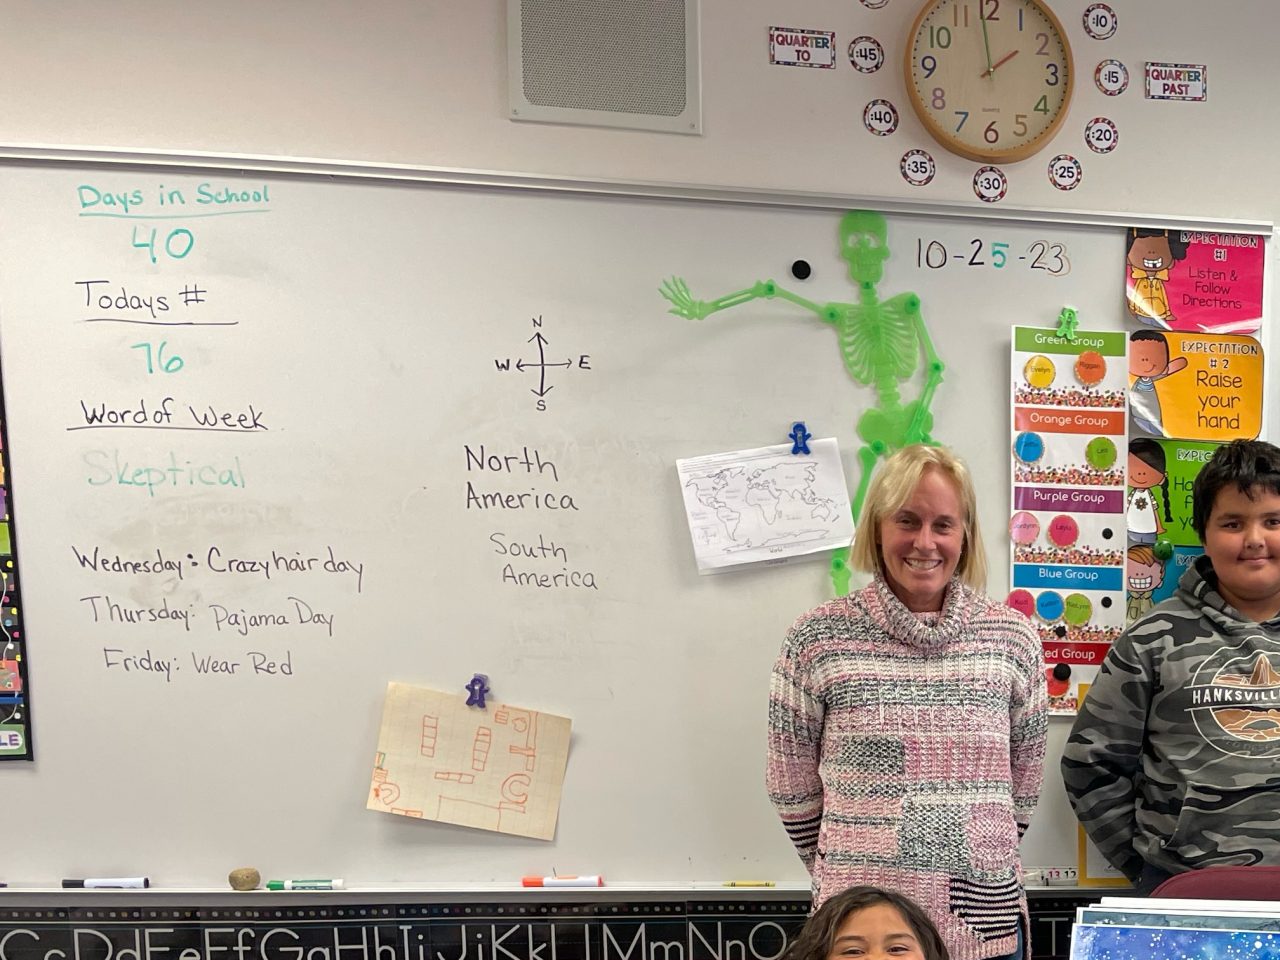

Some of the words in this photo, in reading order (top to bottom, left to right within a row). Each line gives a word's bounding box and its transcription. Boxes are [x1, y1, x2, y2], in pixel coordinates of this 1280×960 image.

[953, 4, 969, 27] 11
[979, 0, 1000, 21] 12
[1018, 8, 1024, 31] 1
[1092, 14, 1108, 28] :10
[775, 33, 830, 49] QUARTER
[929, 25, 951, 49] 10
[1035, 32, 1050, 56] 2
[795, 49, 811, 62] TO
[856, 48, 877, 61] :45
[921, 55, 937, 79] 9
[1045, 63, 1059, 86] 3
[1151, 68, 1201, 82] QUARTER
[1104, 71, 1119, 83] :15
[931, 87, 946, 110] 8
[1162, 83, 1190, 95] PAST
[1033, 94, 1050, 115] 4
[870, 111, 892, 124] :40
[954, 111, 969, 133] 7
[1013, 114, 1028, 137] 5
[984, 120, 999, 144] 6
[1092, 129, 1112, 142] :20
[907, 161, 928, 174] :35
[1055, 166, 1075, 179] :25
[980, 177, 1001, 190] :30
[78, 185, 144, 209] Days
[159, 185, 186, 204] in
[196, 184, 271, 205] School
[130, 227, 194, 264] 40
[1188, 266, 1226, 280] Listen
[1230, 270, 1238, 281] &
[75, 280, 170, 315] Todays
[178, 284, 208, 306] #
[1195, 281, 1231, 295] Follow
[1182, 294, 1242, 310] Directions
[532, 317, 543, 328] N
[1034, 333, 1067, 345] Green
[1181, 340, 1259, 355] EXPECTATION
[130, 342, 184, 374] 76
[494, 358, 511, 371] W
[578, 356, 592, 370] E
[1196, 370, 1243, 389] Raise
[536, 400, 547, 412] S
[1198, 394, 1240, 413] your
[188, 404, 269, 431] Week
[1030, 412, 1071, 426] Orange
[1075, 415, 1108, 427] Group
[1198, 411, 1240, 430] hand
[85, 450, 247, 496] Skeptical
[465, 445, 559, 482] North
[466, 482, 580, 511] America
[1033, 490, 1068, 502] Purple
[1071, 492, 1105, 503] Group
[489, 532, 569, 563] South
[502, 566, 599, 591] America
[1038, 568, 1062, 579] Blue
[1065, 569, 1098, 580] Group
[212, 604, 290, 636] Pajama
[288, 596, 334, 637] Day
[192, 652, 240, 675] Wear
[251, 651, 293, 676] Red
[1044, 648, 1058, 659] ed
[1062, 649, 1095, 660] Group
[749, 921, 787, 960] O
